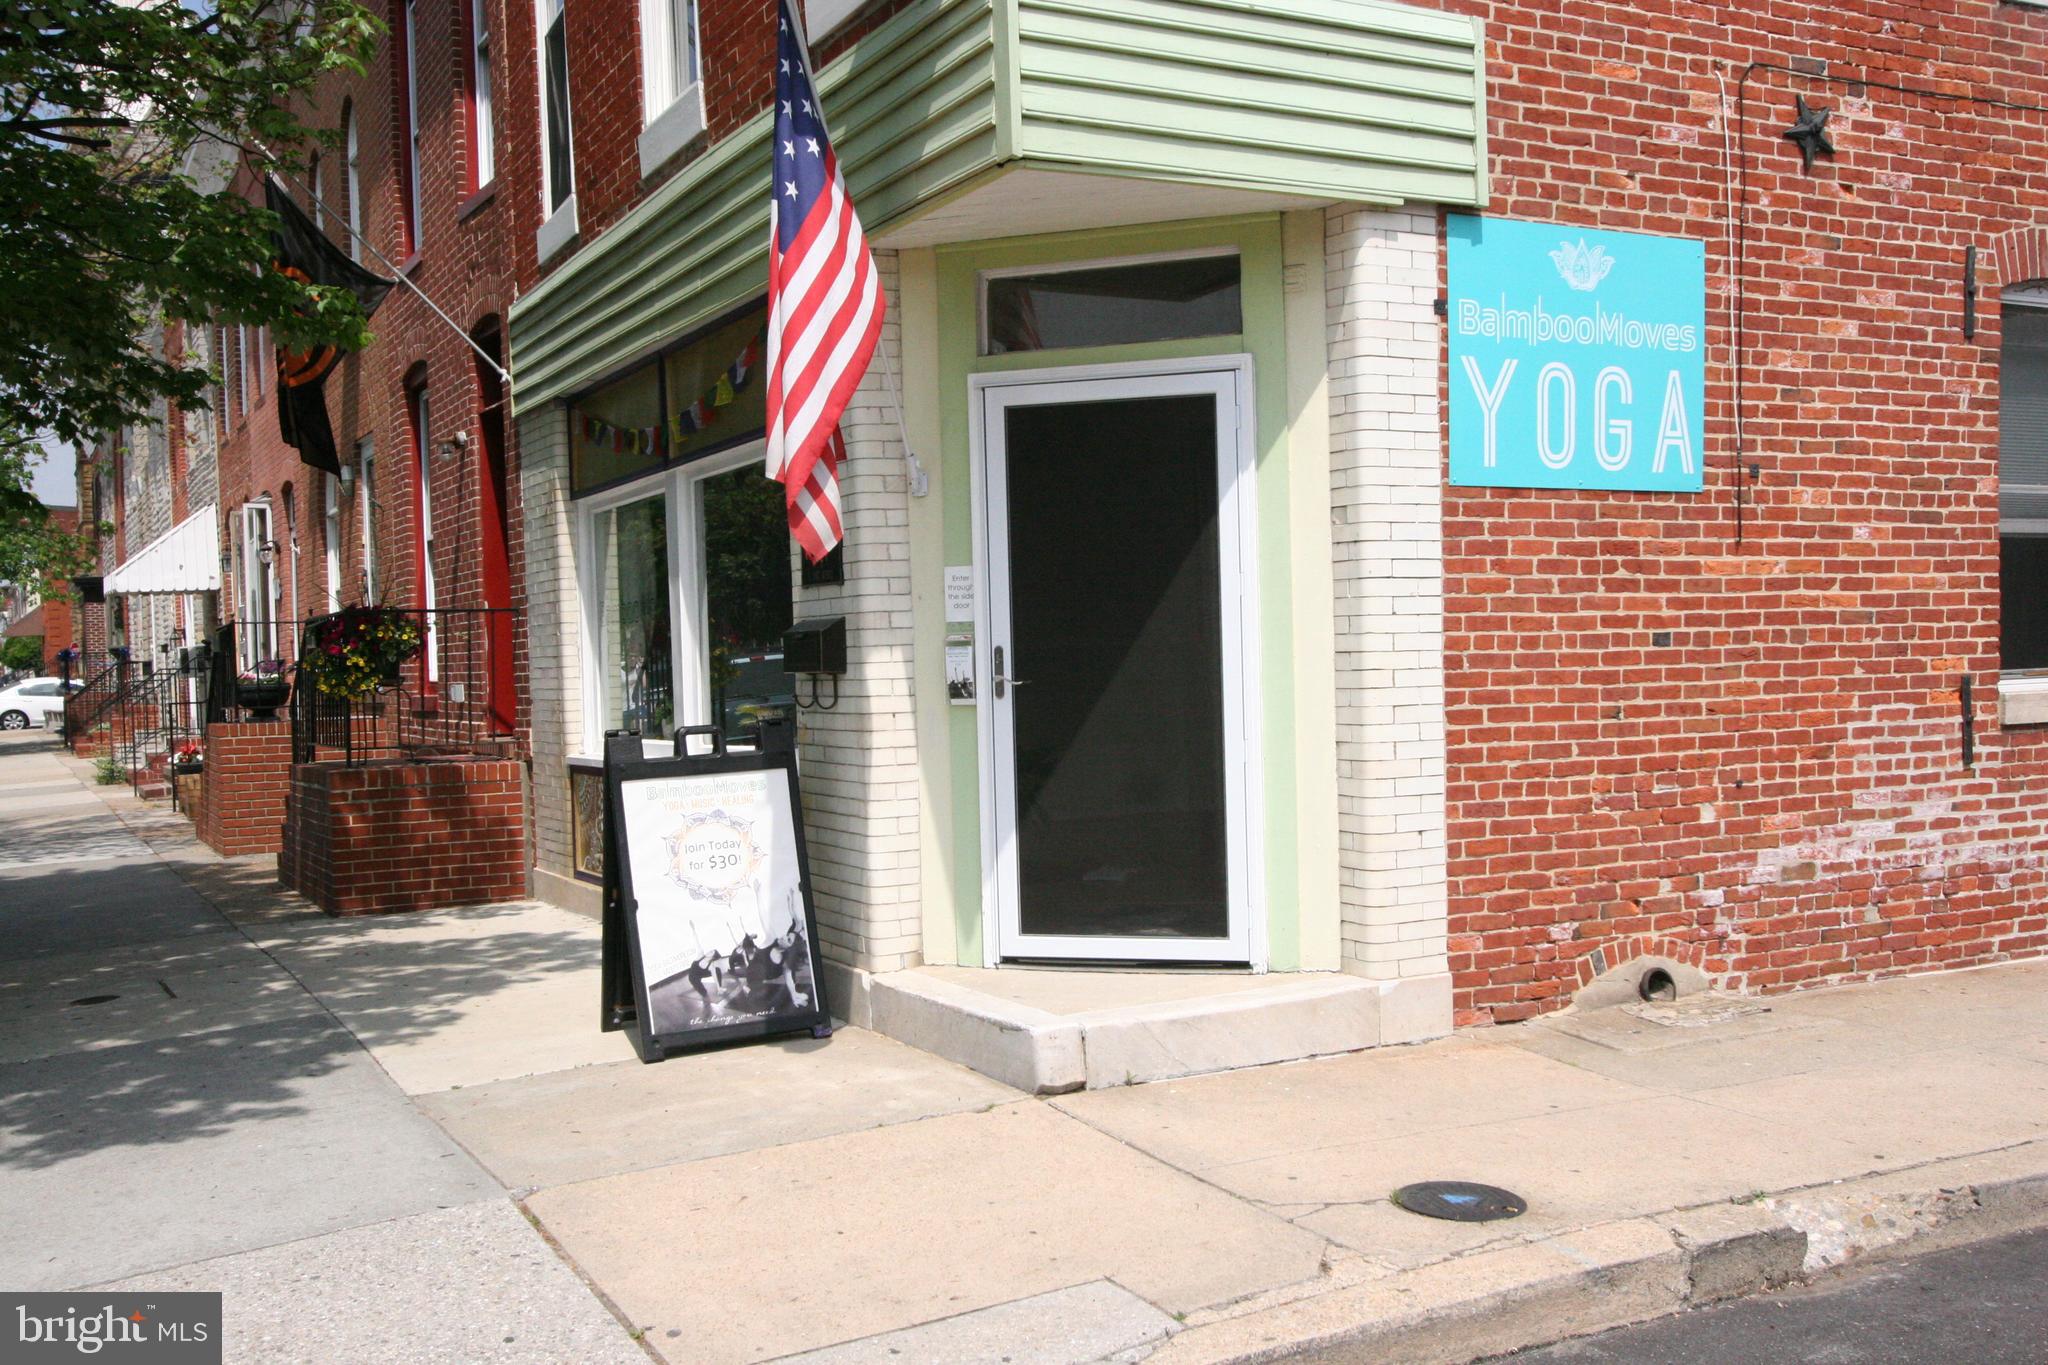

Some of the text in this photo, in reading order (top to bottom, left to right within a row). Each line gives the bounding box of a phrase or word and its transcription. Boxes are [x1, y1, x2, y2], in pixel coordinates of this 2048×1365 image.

[1461, 355, 1695, 475] YOGA
[662, 795, 753, 811] YOGA MUSIC HEALING
[685, 840, 742, 855] Join Today
[689, 854, 743, 870] for $30!
[689, 1016, 704, 1025] the
